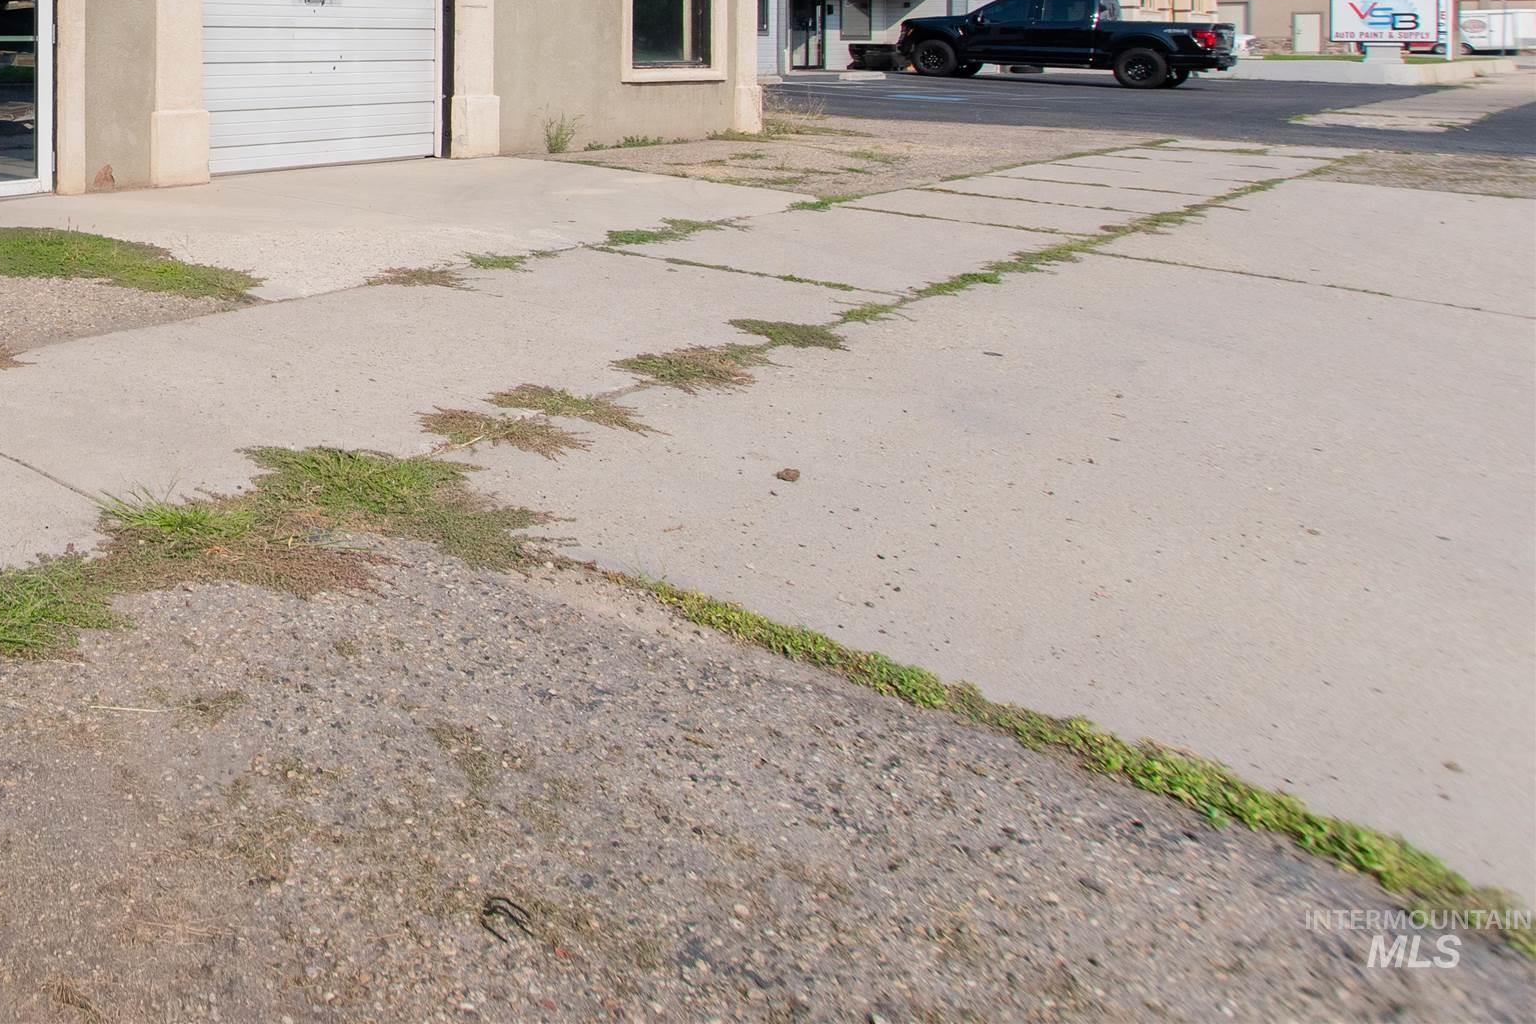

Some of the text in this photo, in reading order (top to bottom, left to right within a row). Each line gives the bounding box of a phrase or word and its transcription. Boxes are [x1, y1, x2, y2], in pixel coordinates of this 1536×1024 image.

[1348, 1, 1420, 31] VSB
[1334, 31, 1430, 39] AUTO PAINT & SUPPLY
